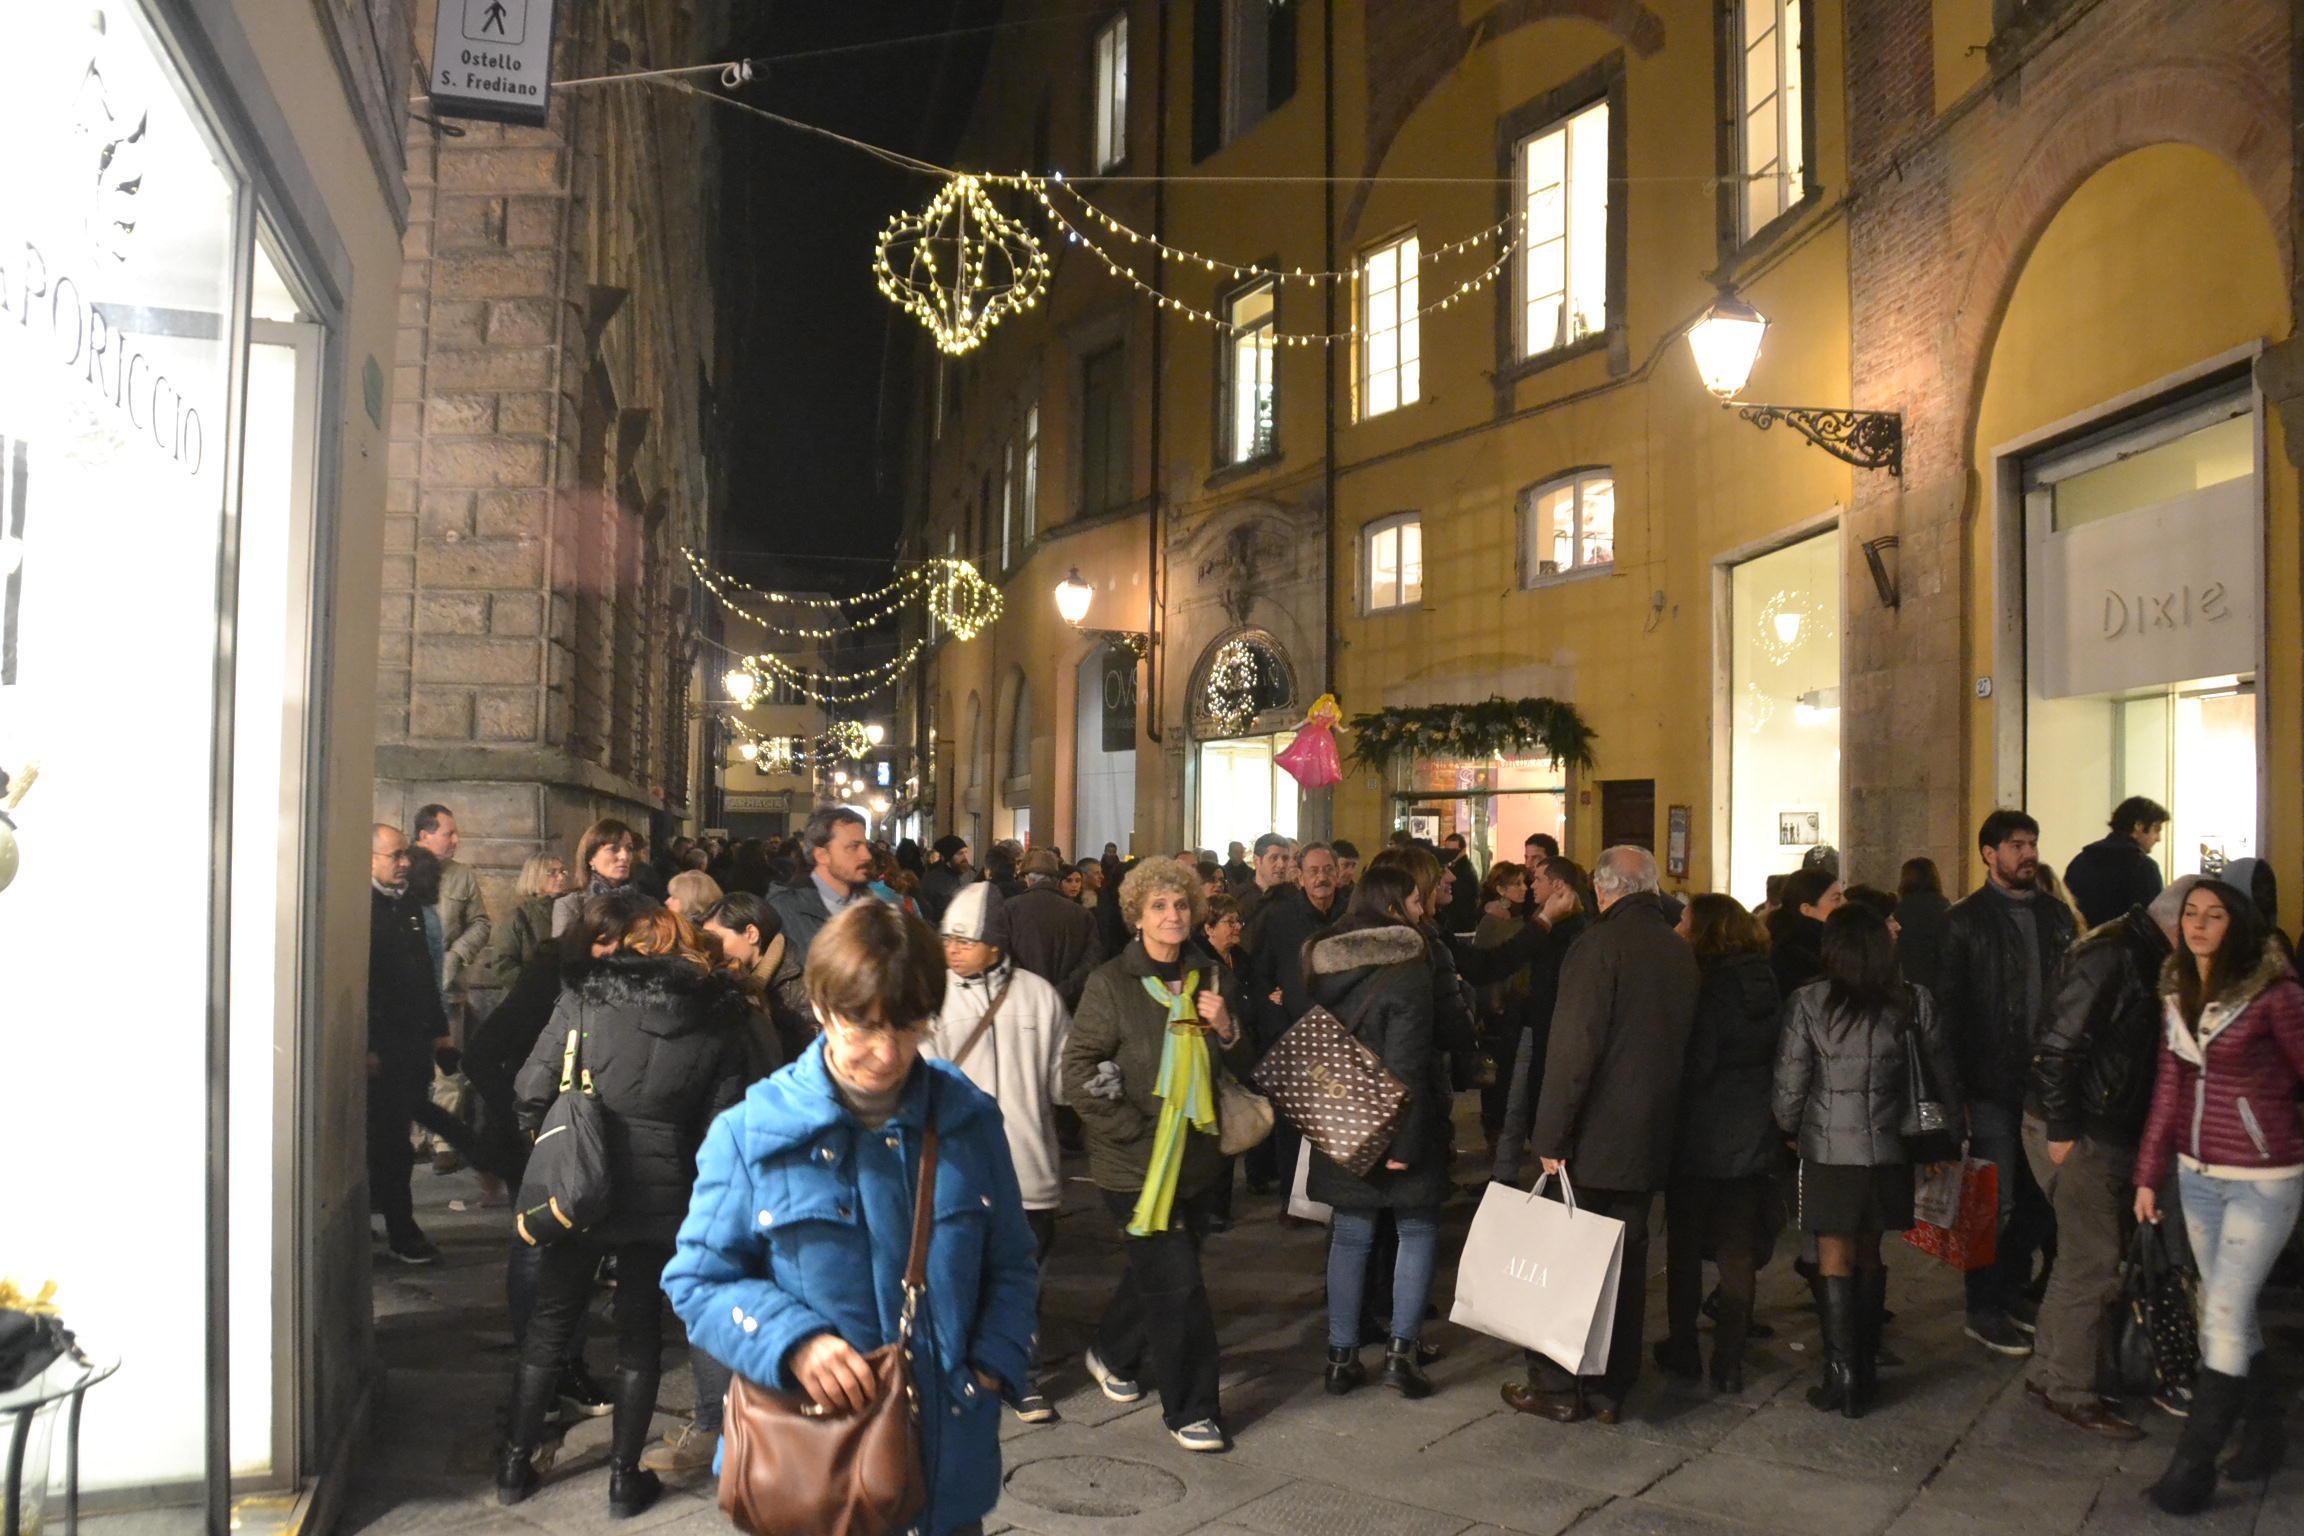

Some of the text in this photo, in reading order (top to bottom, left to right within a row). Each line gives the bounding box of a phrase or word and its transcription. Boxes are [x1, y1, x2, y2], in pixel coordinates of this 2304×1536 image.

[461, 49, 522, 71] Ostello
[441, 70, 537, 96] S. Frediano
[1503, 1255, 1549, 1288] ALIA
